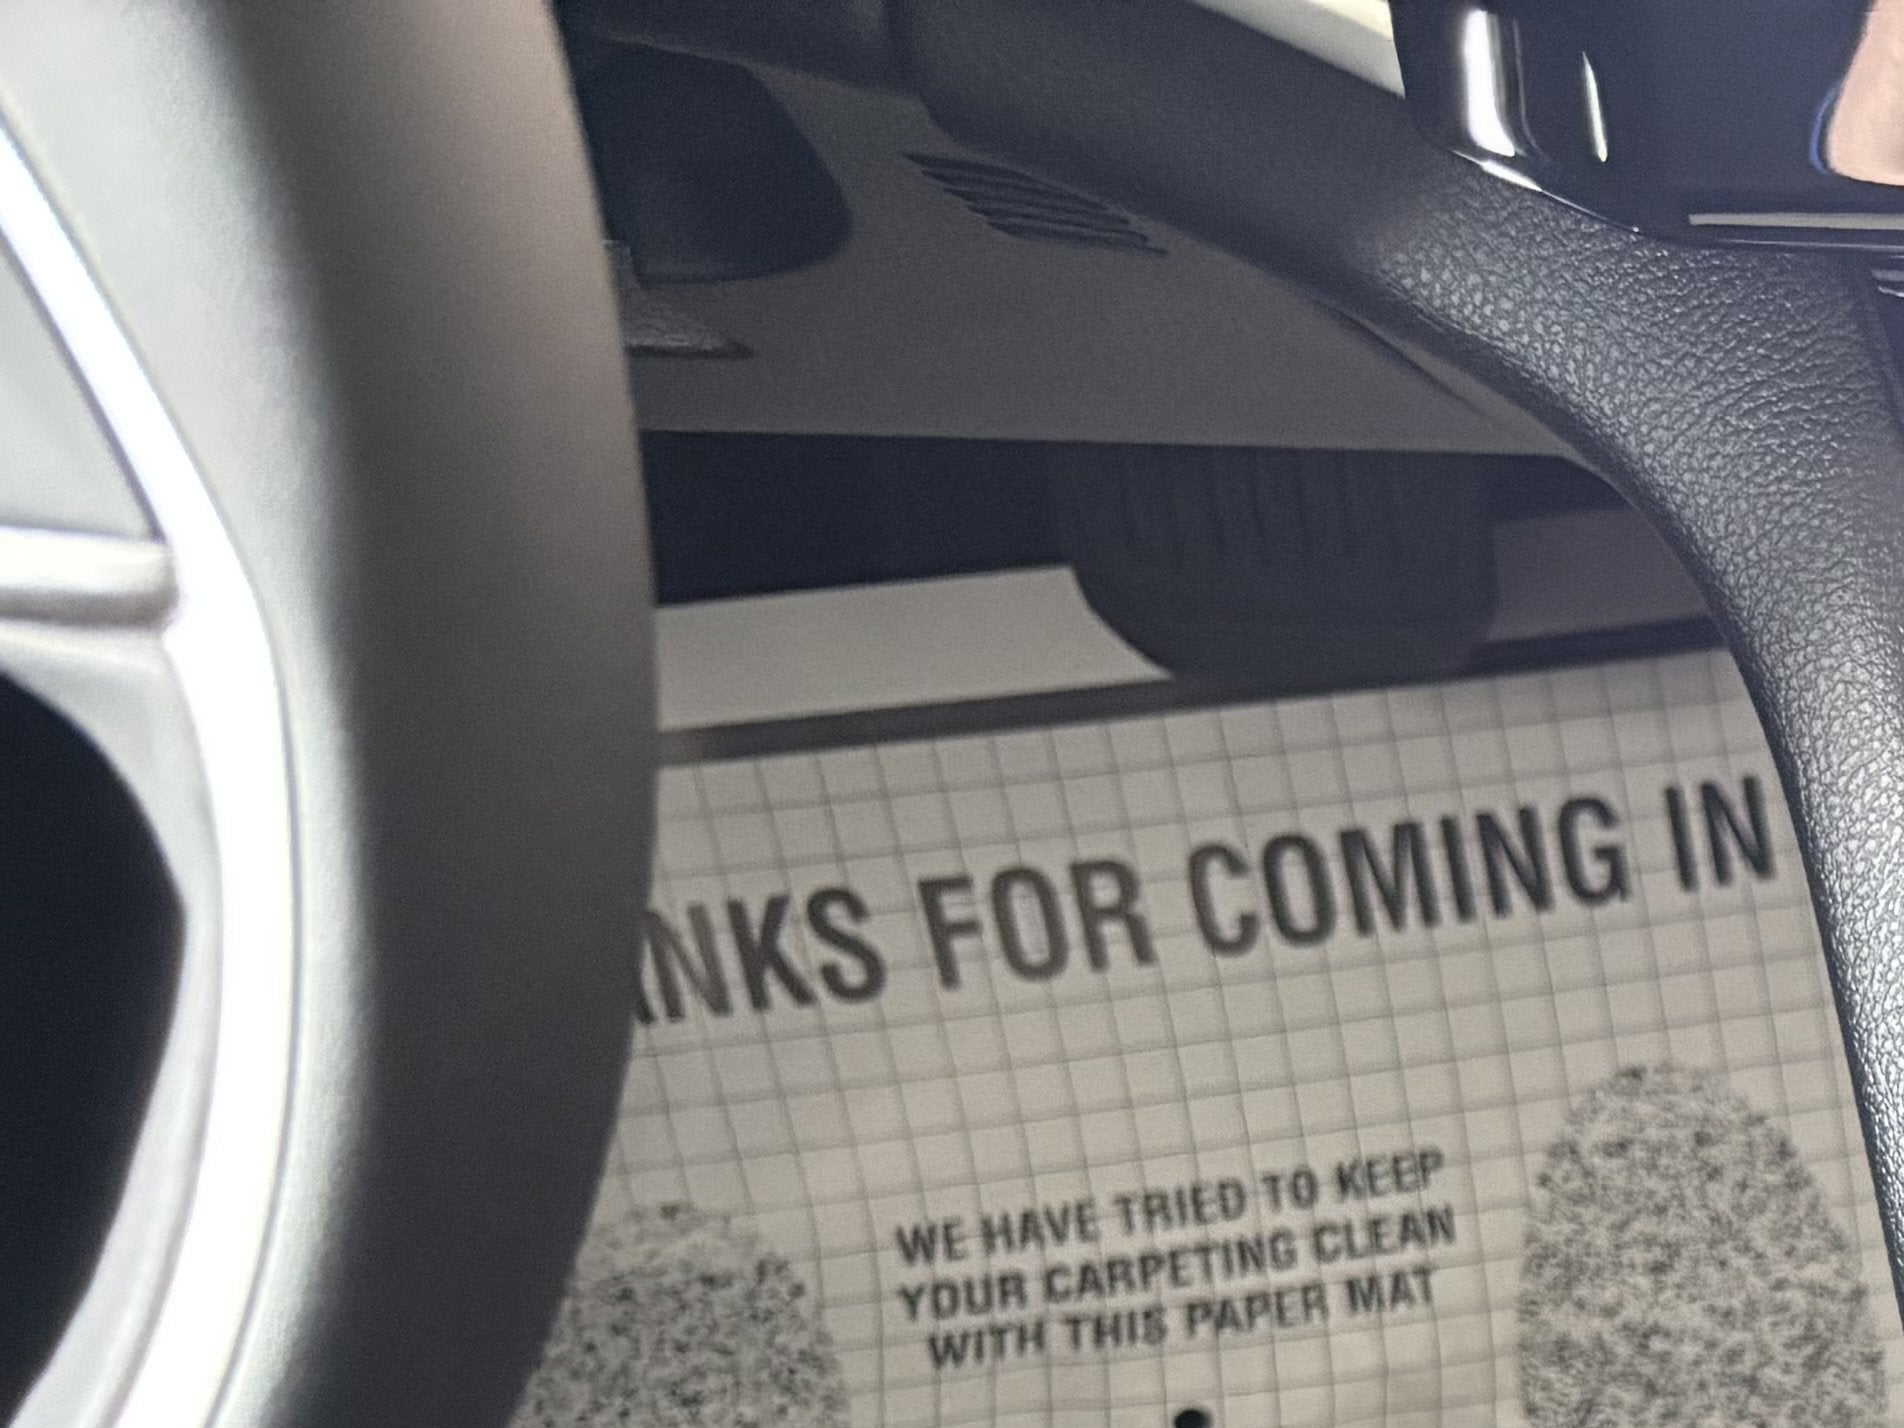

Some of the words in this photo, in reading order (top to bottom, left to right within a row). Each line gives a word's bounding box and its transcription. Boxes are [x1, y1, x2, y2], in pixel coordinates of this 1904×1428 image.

[636, 886, 888, 1025] NKS
[918, 858, 1157, 991] FOR
[1187, 796, 1632, 958] COMING
[1666, 774, 1775, 893] IN
[897, 1216, 966, 1266] WE
[980, 1203, 1102, 1255] HAVE
[1112, 1176, 1248, 1235] TRIED
[1261, 1165, 1318, 1211] TO
[1336, 1145, 1445, 1201] KEEP
[898, 1272, 1026, 1323] YOUR
[1043, 1227, 1297, 1304] CARPETING
[1312, 1204, 1457, 1265] CLEAN
[928, 1319, 1046, 1371] WITH
[1065, 1304, 1167, 1351] THIS
[1185, 1281, 1330, 1340] PAPER
[1345, 1264, 1440, 1316] MAT
